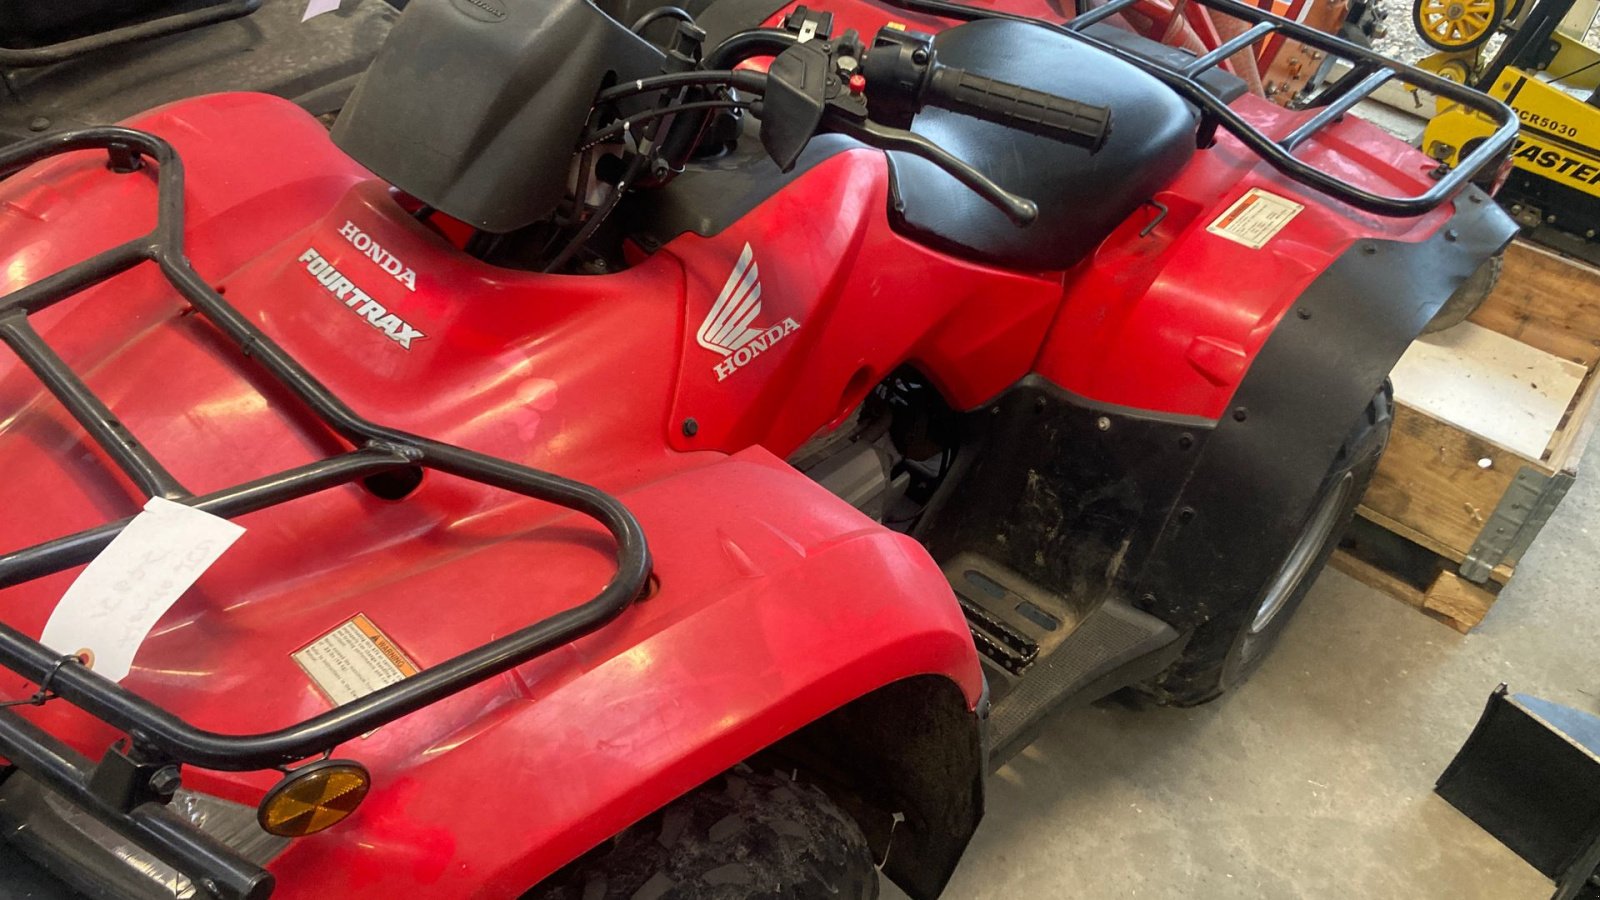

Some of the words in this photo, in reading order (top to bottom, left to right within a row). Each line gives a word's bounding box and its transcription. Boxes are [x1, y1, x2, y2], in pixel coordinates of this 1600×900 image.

[338, 220, 417, 293] HONDA
[298, 248, 426, 351] FOURTRAX
[713, 317, 801, 383] HONDA
[377, 641, 405, 668] WARNING
